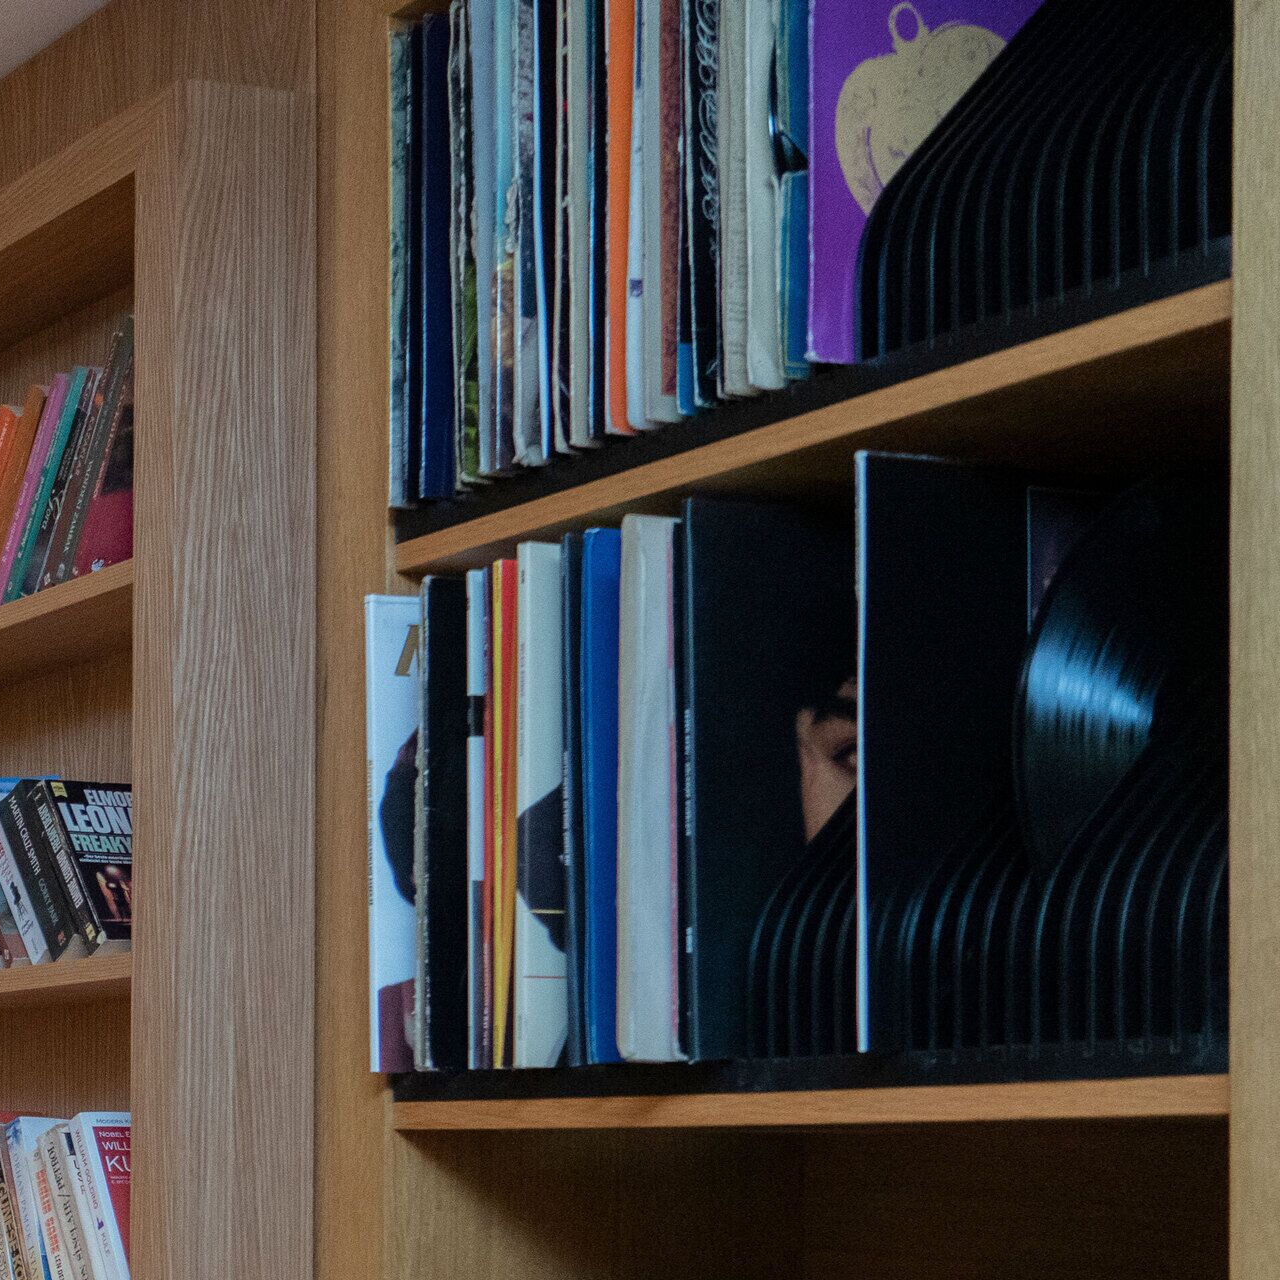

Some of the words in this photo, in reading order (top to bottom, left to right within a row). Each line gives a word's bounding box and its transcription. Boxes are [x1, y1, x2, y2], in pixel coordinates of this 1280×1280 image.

[8, 795, 22, 828] MARTIN
[18, 825, 31, 848] CRUZ
[27, 847, 41, 876] SMITH
[57, 802, 132, 836] LEON
[11, 1152, 23, 1196] ORHAN
[20, 1199, 32, 1242] PAMUK
[74, 1130, 88, 1167] WILLIAM
[83, 1168, 98, 1209] GOLDING
